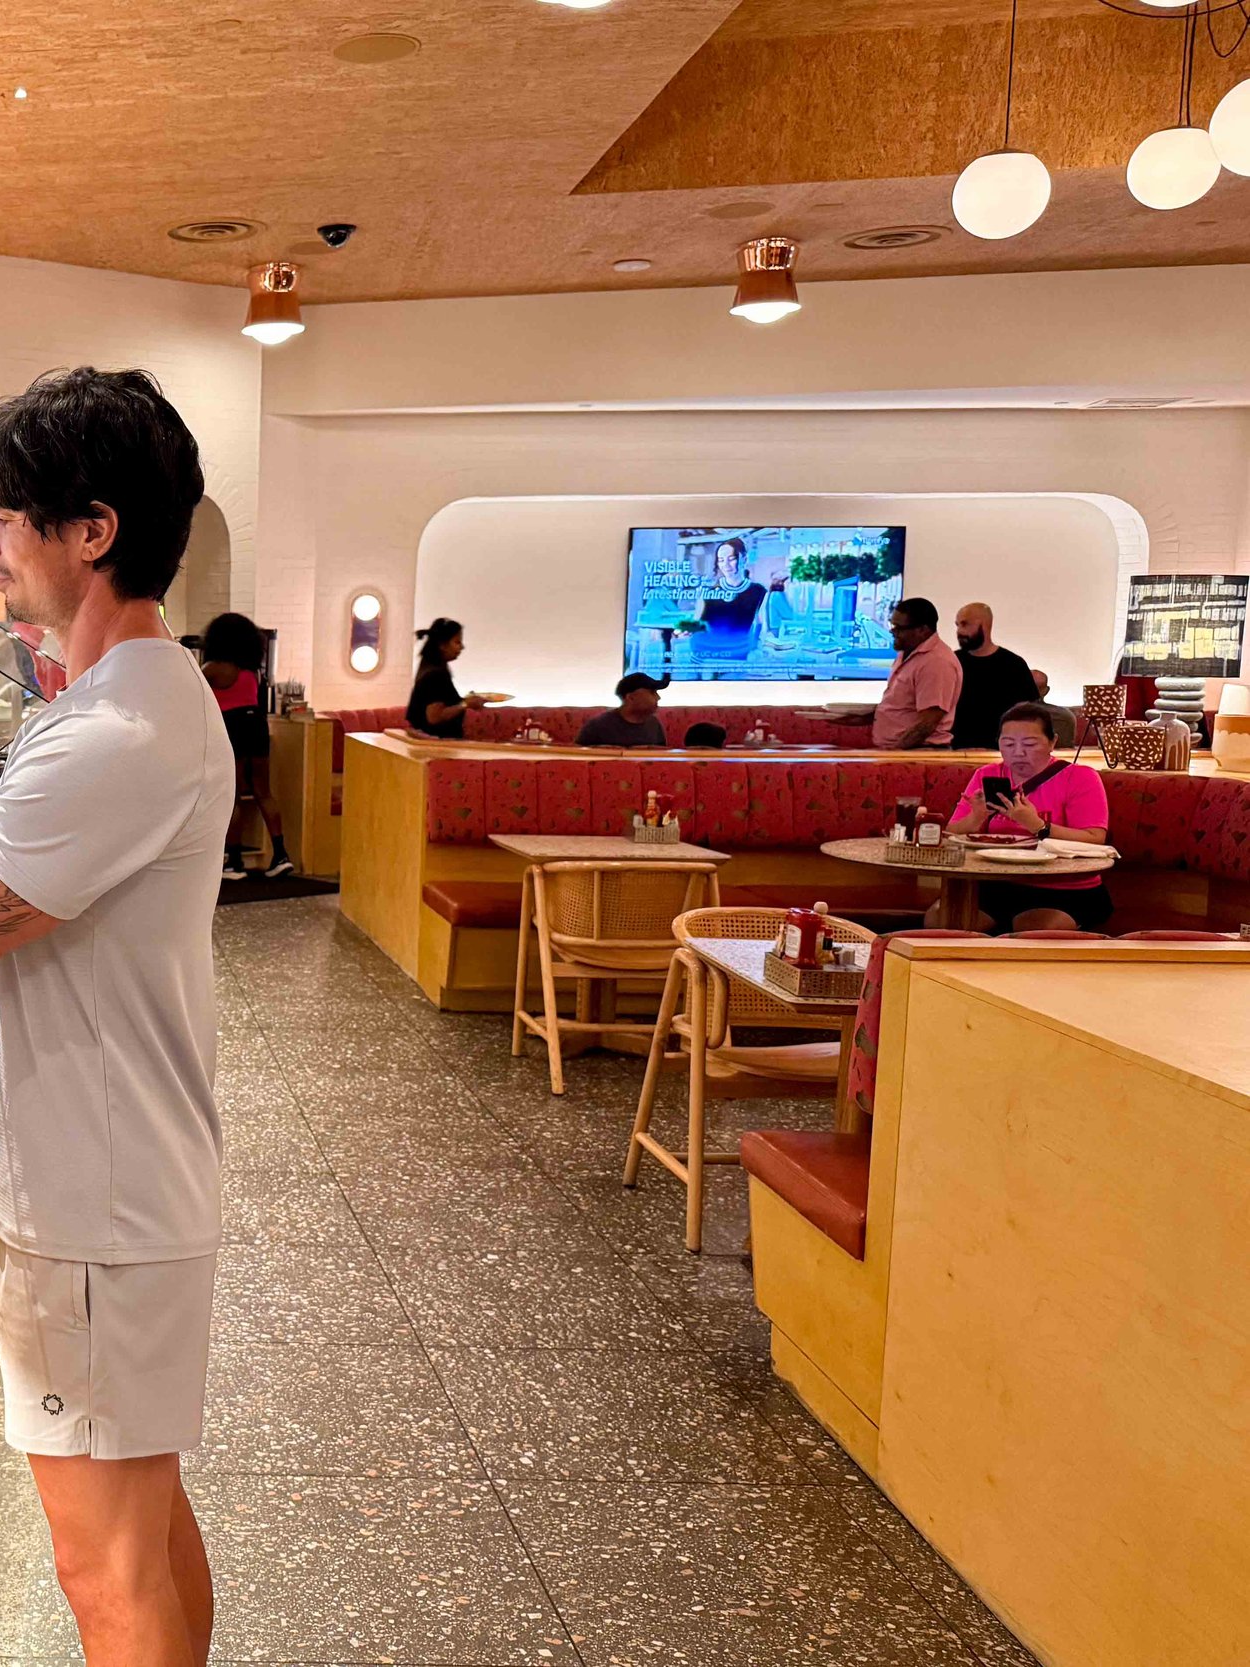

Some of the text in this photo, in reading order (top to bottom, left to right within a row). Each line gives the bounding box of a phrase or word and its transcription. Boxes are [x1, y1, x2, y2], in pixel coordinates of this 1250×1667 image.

[644, 560, 691, 573] VISIBLE
[644, 574, 700, 587] HEALING
[643, 587, 734, 602] intestinal lining
